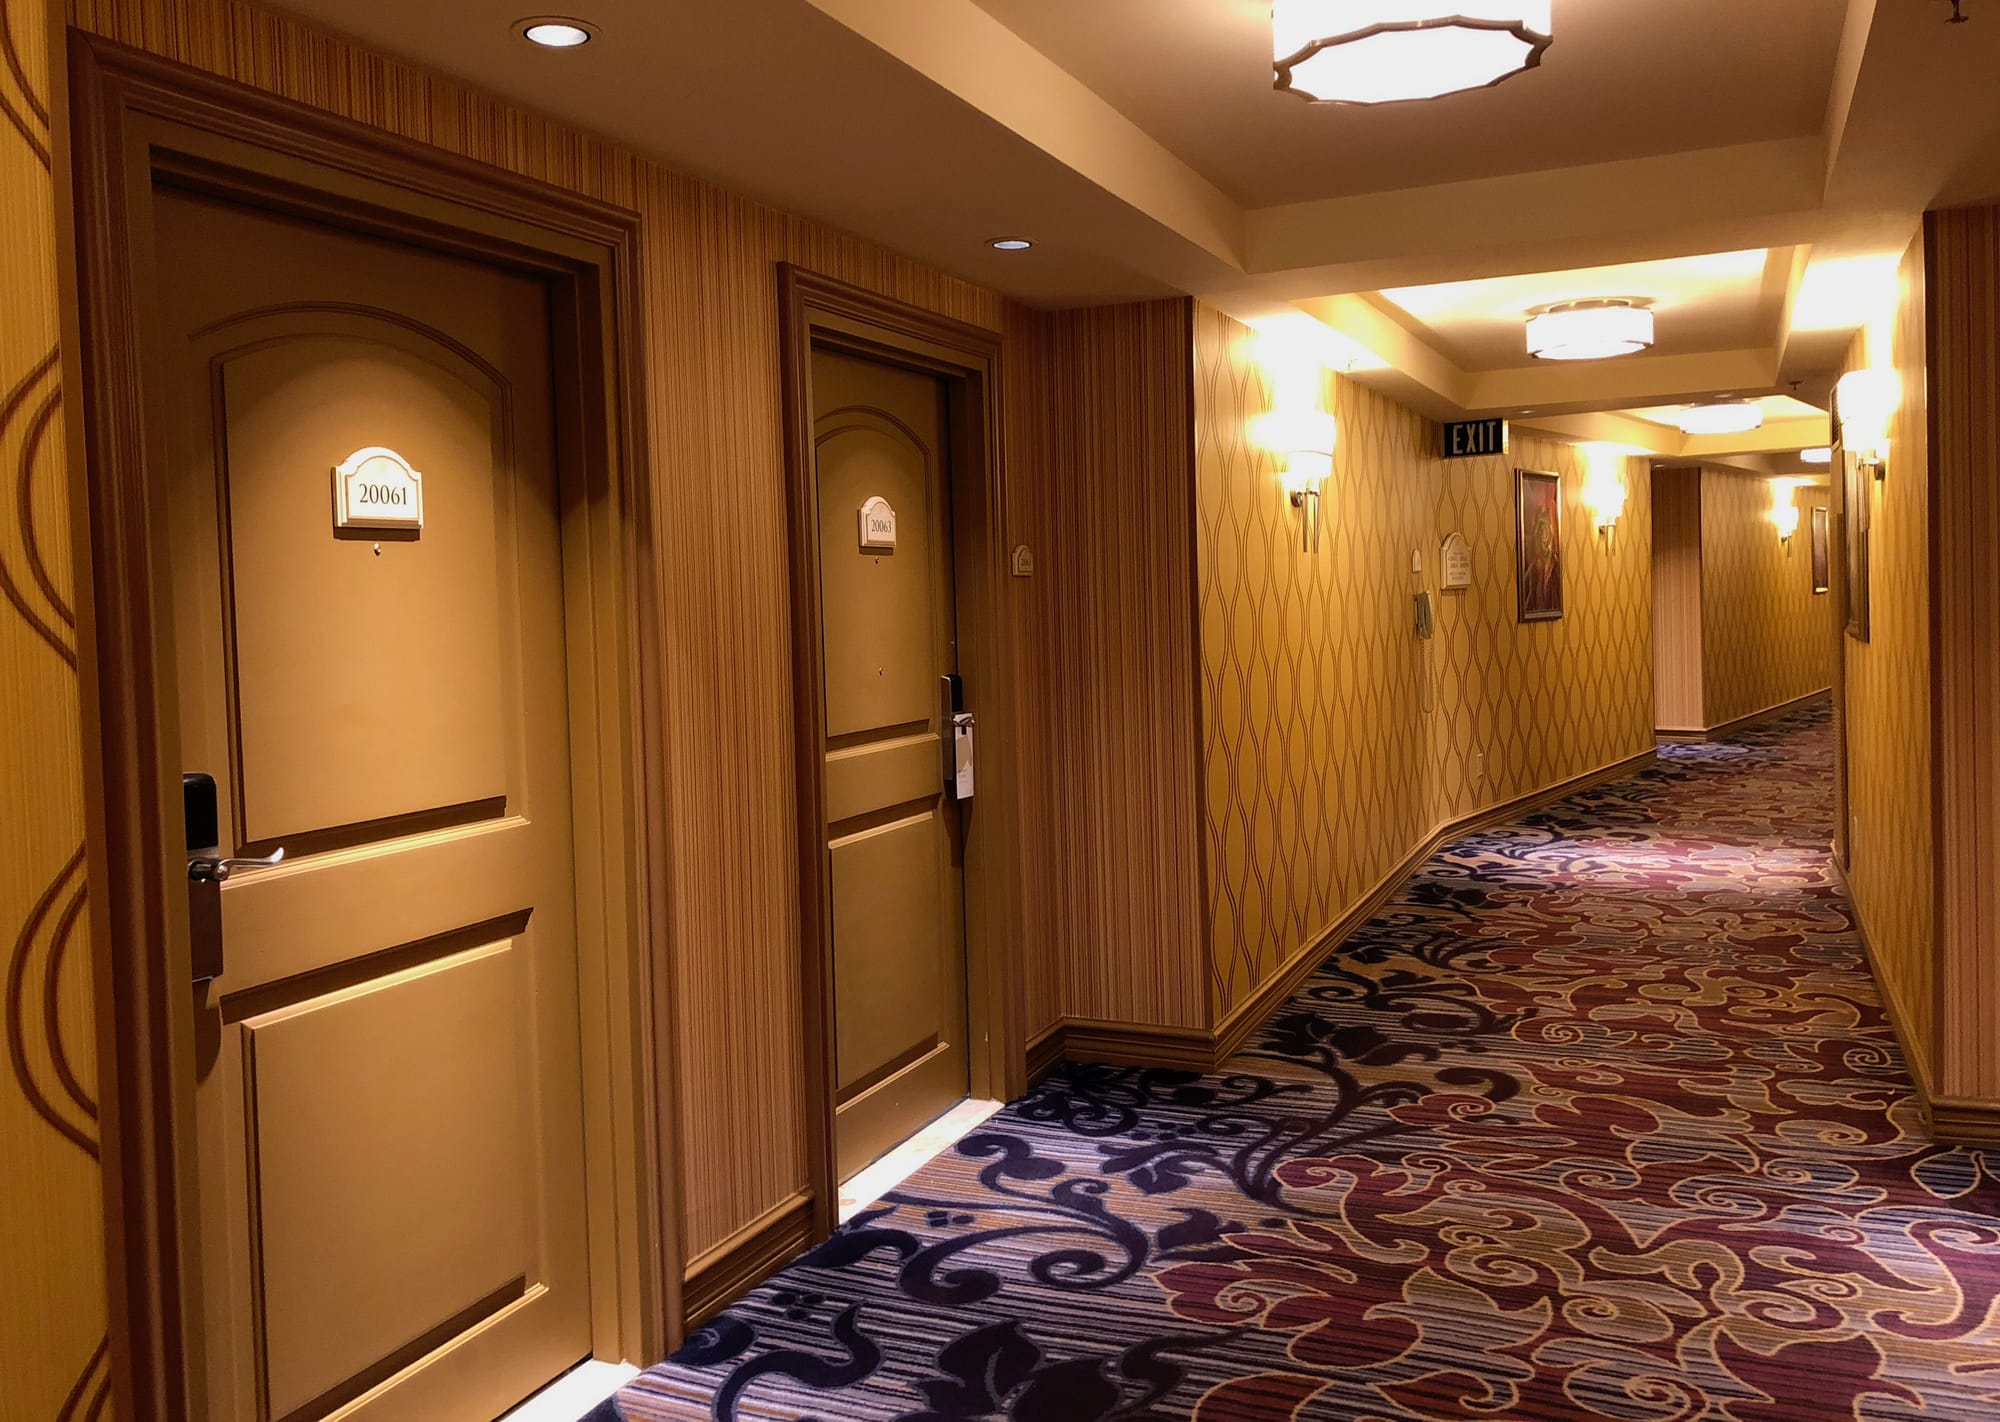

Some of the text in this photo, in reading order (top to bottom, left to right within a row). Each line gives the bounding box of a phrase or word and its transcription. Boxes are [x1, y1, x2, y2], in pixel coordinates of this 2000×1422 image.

[1453, 421, 1497, 455] EXIT
[359, 483, 407, 506] 20061
[871, 519, 892, 533] 20063
